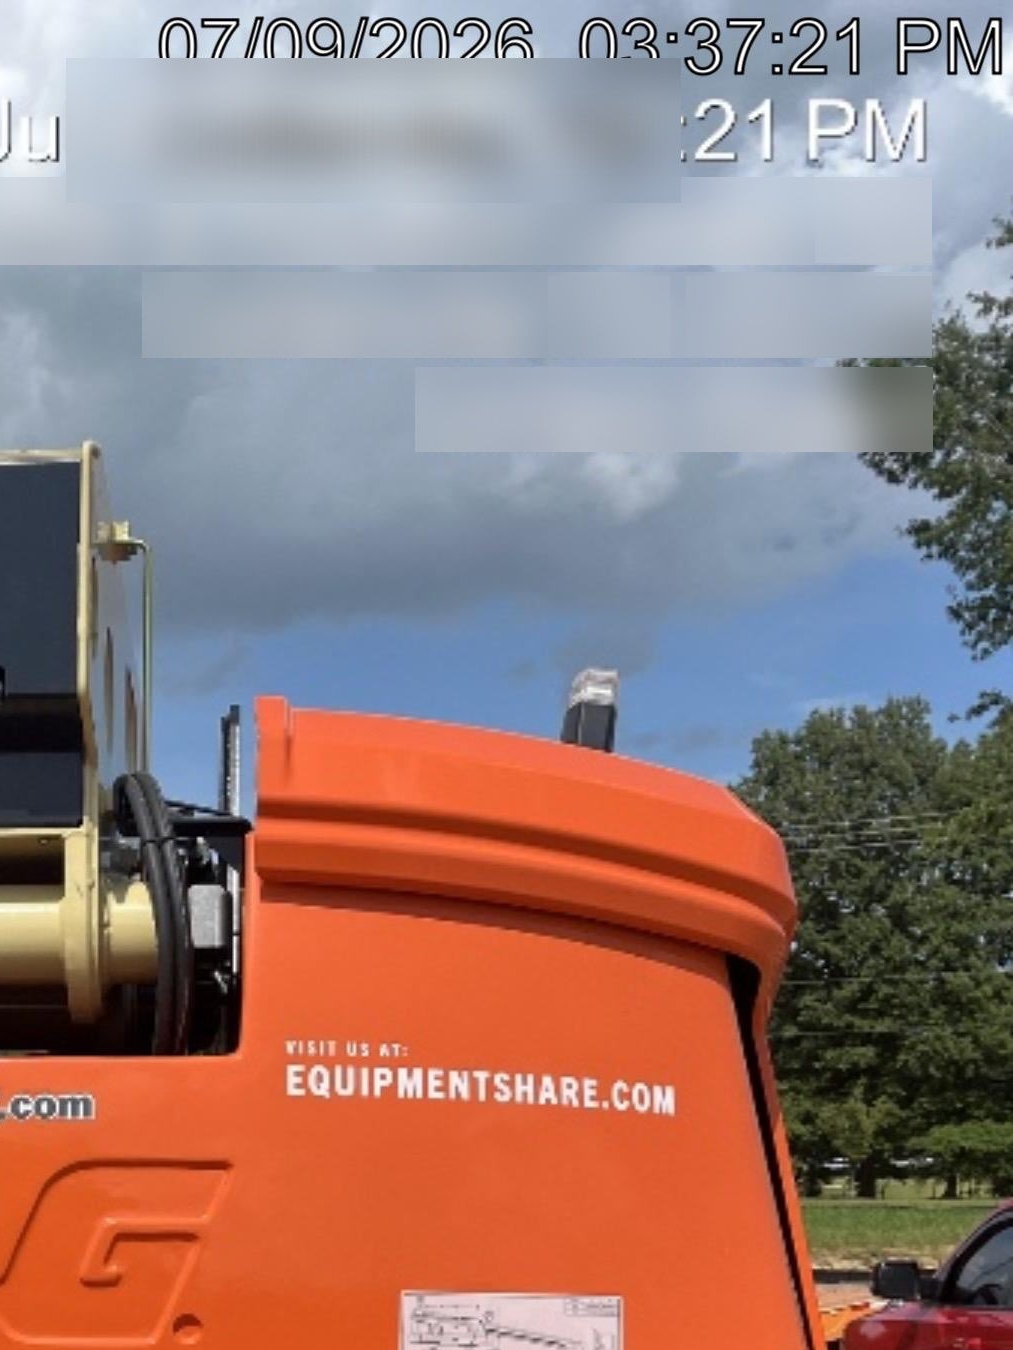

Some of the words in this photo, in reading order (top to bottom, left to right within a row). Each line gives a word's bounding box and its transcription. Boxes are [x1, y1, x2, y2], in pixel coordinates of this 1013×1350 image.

[285, 1039, 337, 1057] VISIT
[346, 1039, 370, 1058] US
[379, 1042, 409, 1058] AT:
[285, 1063, 678, 1116] EQUIPMENTSHARE.COM
